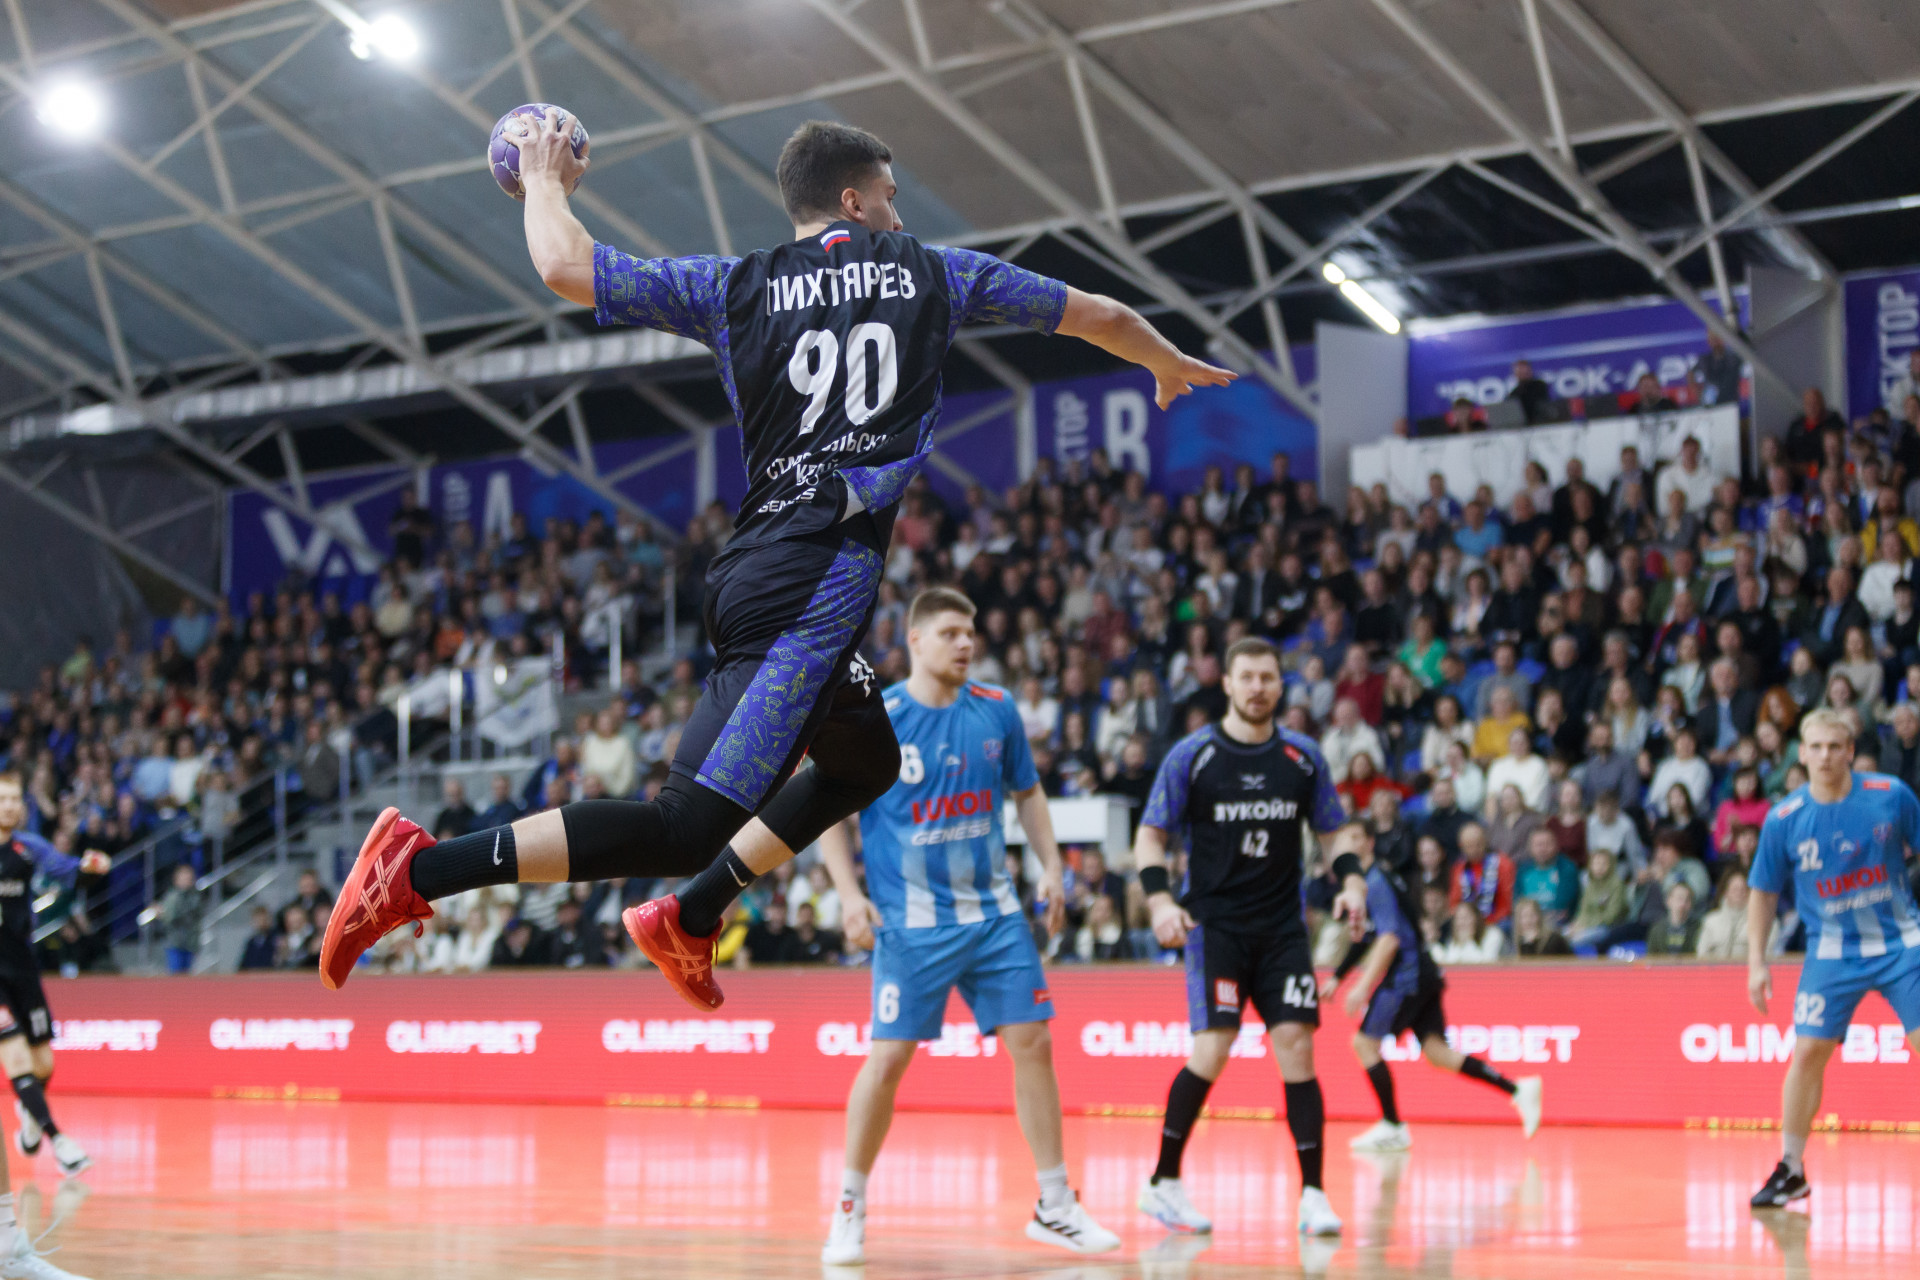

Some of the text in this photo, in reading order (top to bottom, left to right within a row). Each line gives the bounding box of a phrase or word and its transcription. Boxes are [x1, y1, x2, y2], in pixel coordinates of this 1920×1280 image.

[788, 321, 898, 437] 90
[1241, 829, 1270, 859] 42
[878, 983, 900, 1024] 6
[1283, 974, 1317, 1009] 42
[1795, 992, 1826, 1027] 32
[49, 1020, 162, 1051] LIMPBET
[210, 1018, 354, 1050] OLIMPBET
[386, 1020, 542, 1054] OLIMPBET
[602, 1019, 774, 1053] OLIMPBET
